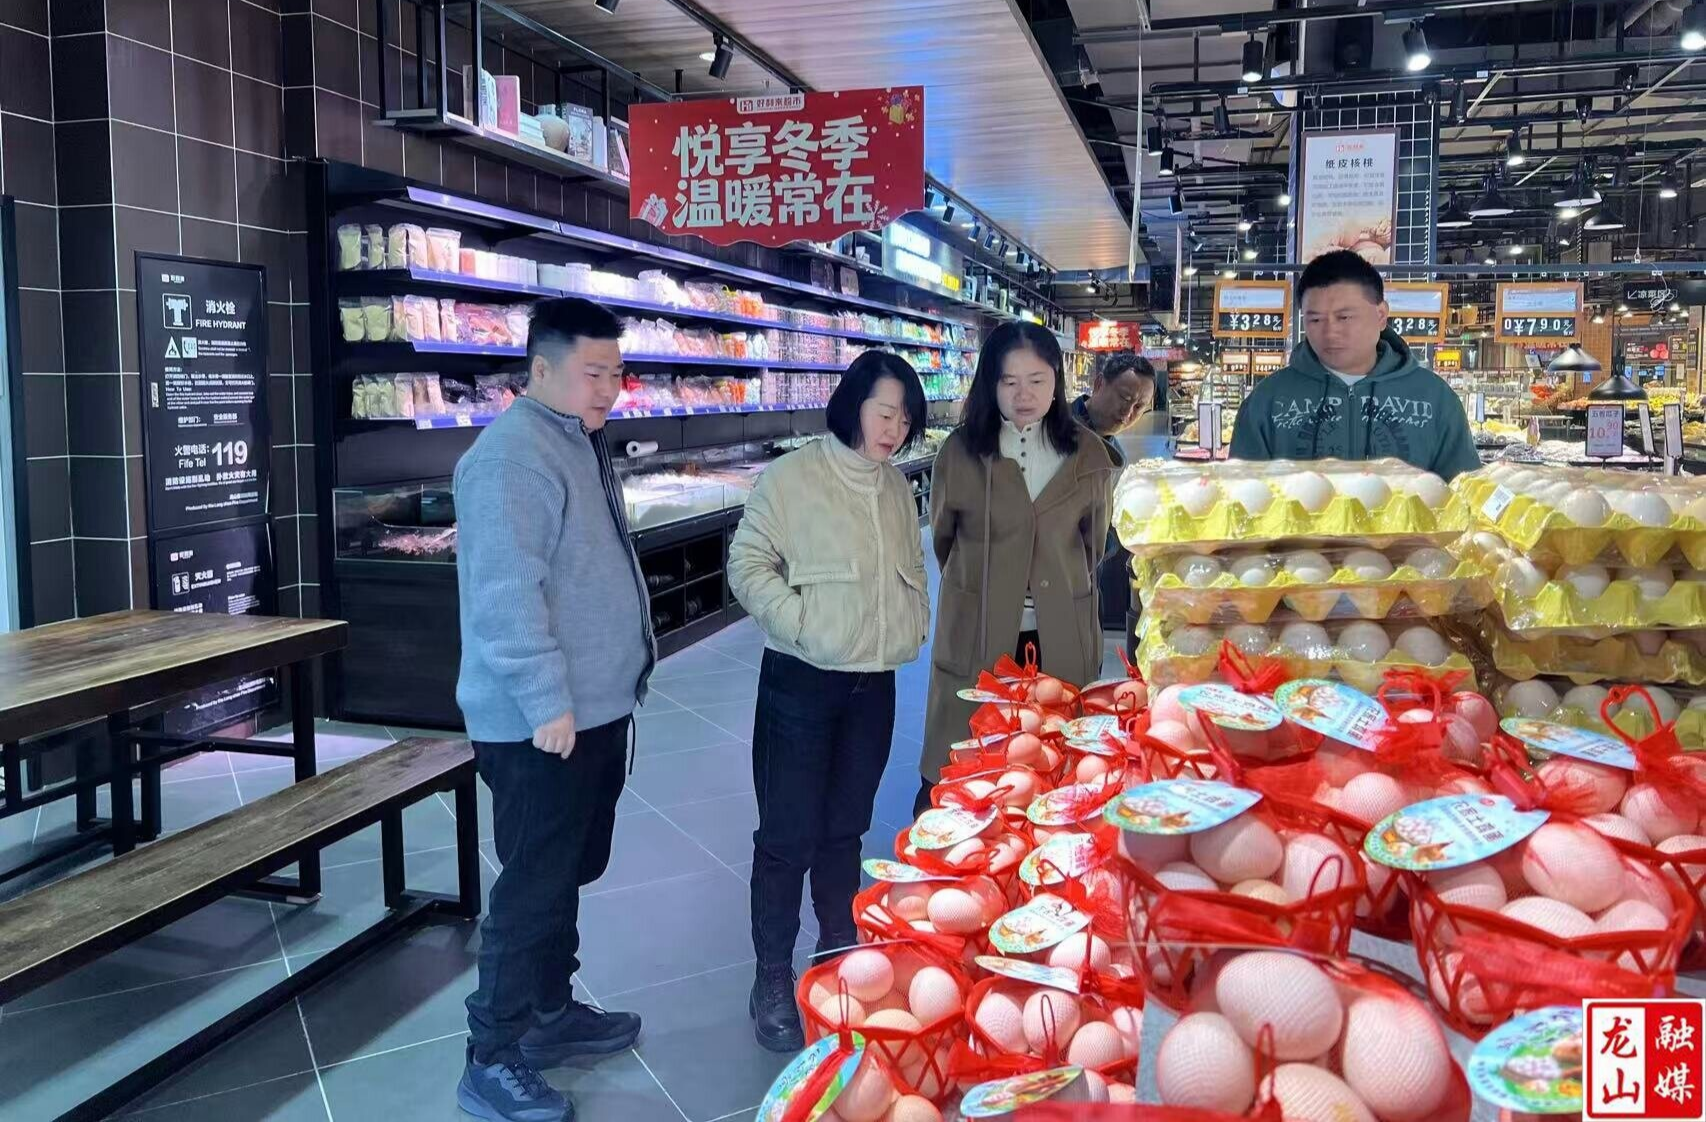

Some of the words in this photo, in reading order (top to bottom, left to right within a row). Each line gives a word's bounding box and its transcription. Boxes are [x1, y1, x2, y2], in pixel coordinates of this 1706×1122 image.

[672, 115, 870, 178] 悦享冬季
[672, 170, 876, 228] 温暖常在
[205, 299, 236, 315] 消火栓
[195, 318, 212, 328] FIRE
[213, 320, 247, 329] HYDRANT
[1360, 396, 1433, 419] DAVID
[195, 457, 207, 467] Tel
[211, 440, 248, 466] 119
